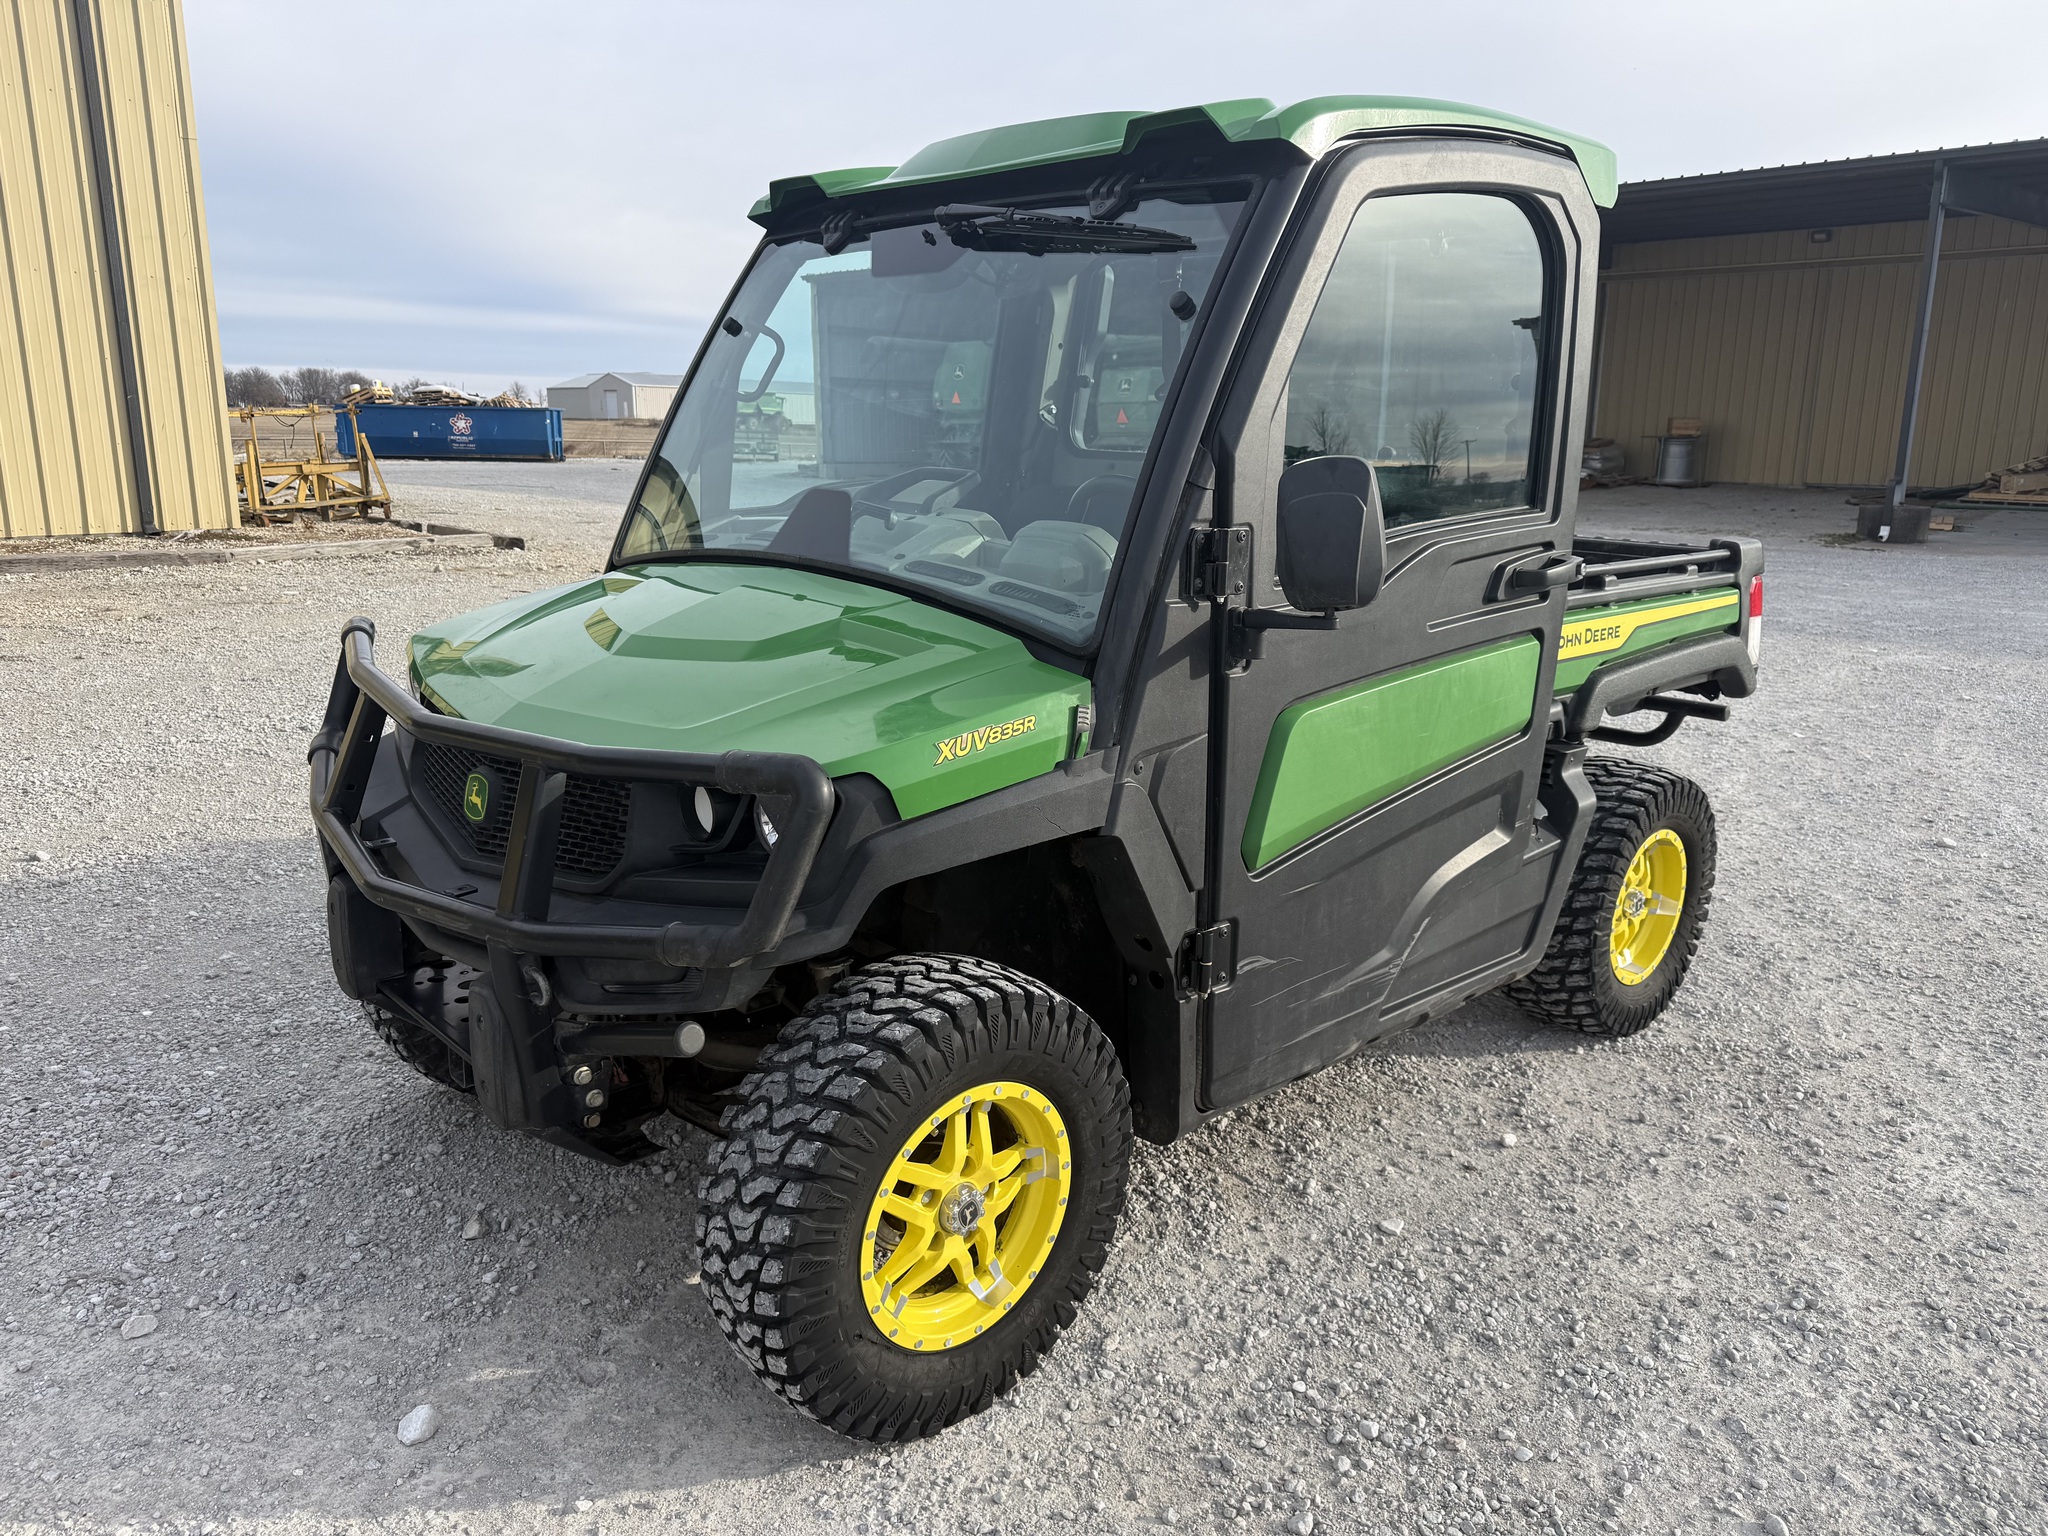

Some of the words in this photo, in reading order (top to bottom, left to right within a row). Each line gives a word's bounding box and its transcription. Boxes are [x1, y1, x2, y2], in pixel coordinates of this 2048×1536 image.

[1558, 632, 1582, 649] OHN
[1584, 625, 1621, 645] DEERE
[933, 715, 1037, 766] XUV835R
